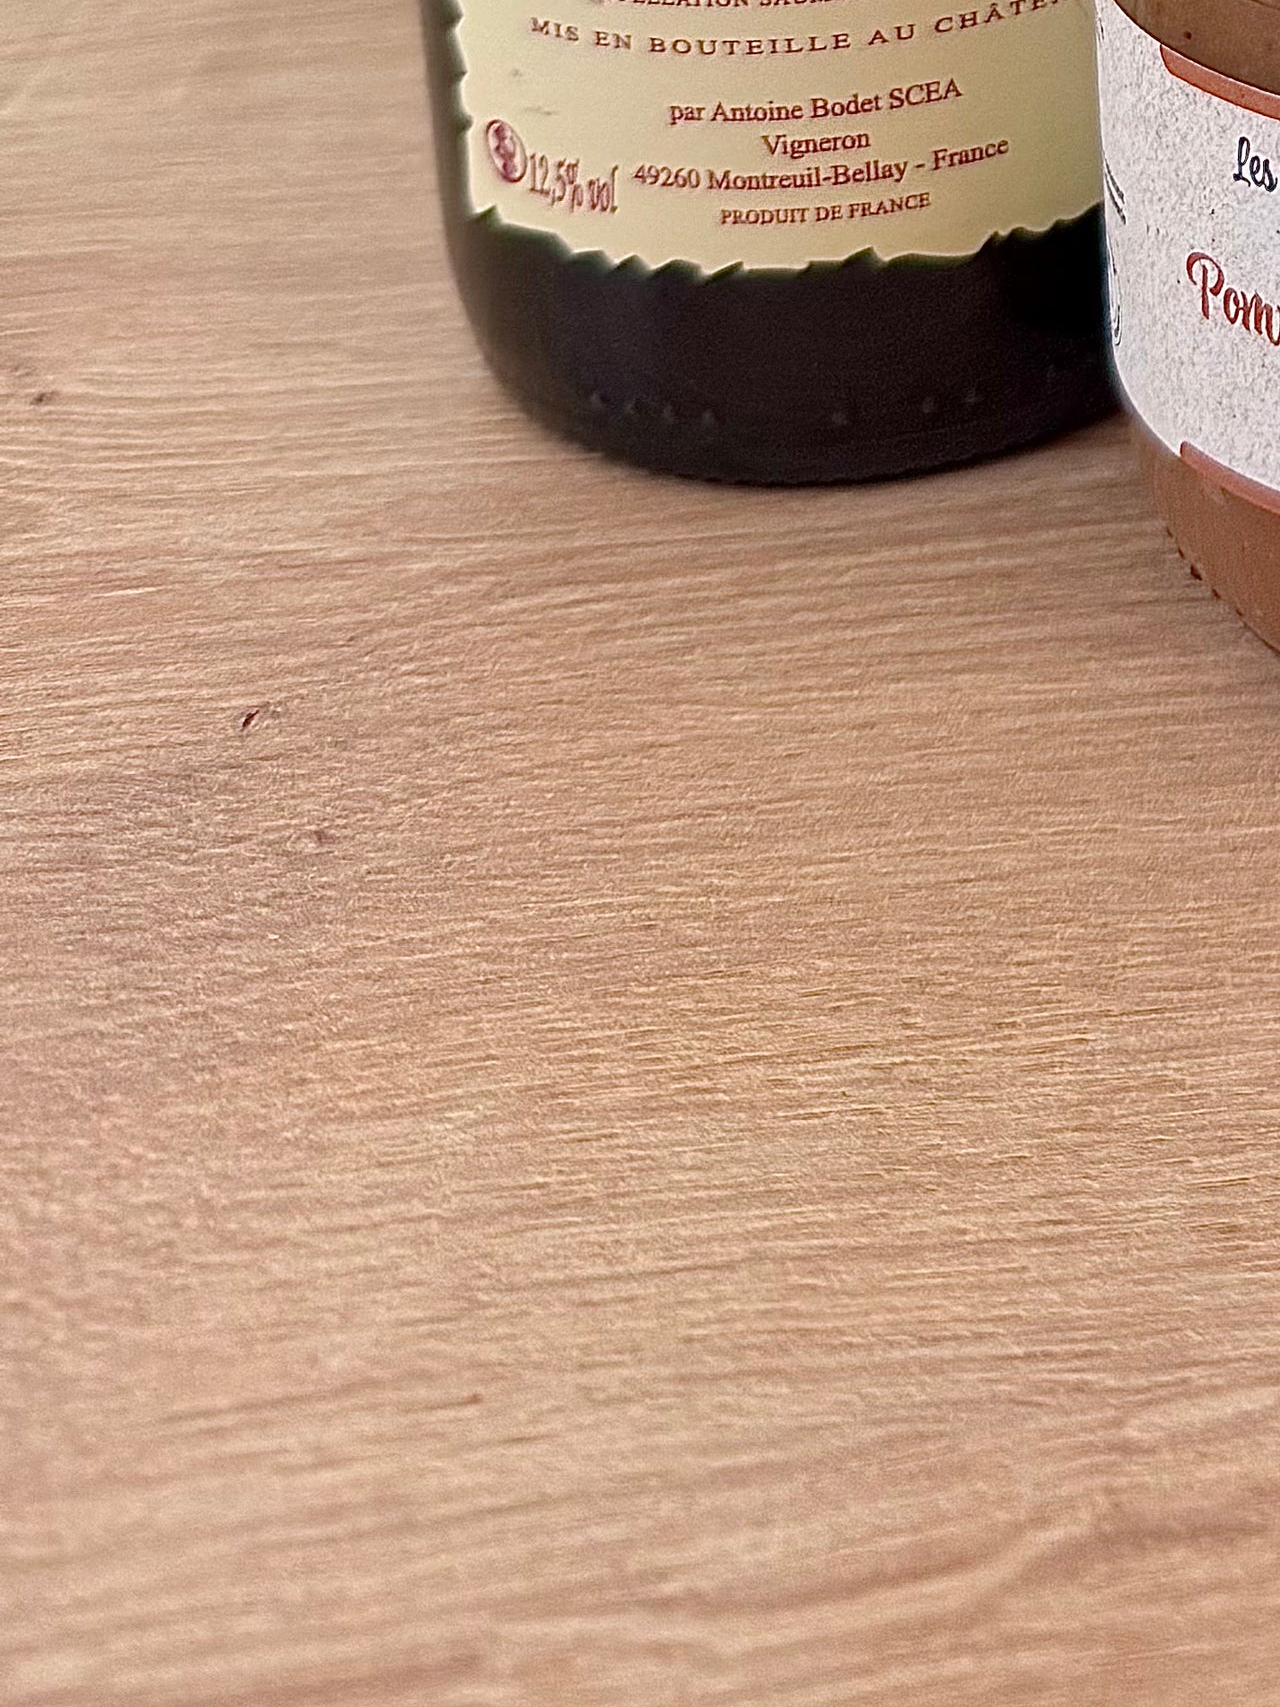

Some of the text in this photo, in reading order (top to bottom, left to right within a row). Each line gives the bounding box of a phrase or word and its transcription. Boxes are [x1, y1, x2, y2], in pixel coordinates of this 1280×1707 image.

[529, 15, 579, 42] MIS
[595, 30, 632, 50] EN
[650, 31, 852, 56] BOUTEILLE
[868, 23, 916, 47] AU
[670, 78, 963, 125] par Antoine Bodet SCEA
[633, 164, 700, 189] 49260
[707, 156, 909, 190] Montreuil-Bellay
[932, 137, 1009, 172] France
[761, 130, 871, 158] Vigneron
[1233, 136, 1277, 192] Les
[720, 192, 931, 225] PRODUIT DE FRANCE
